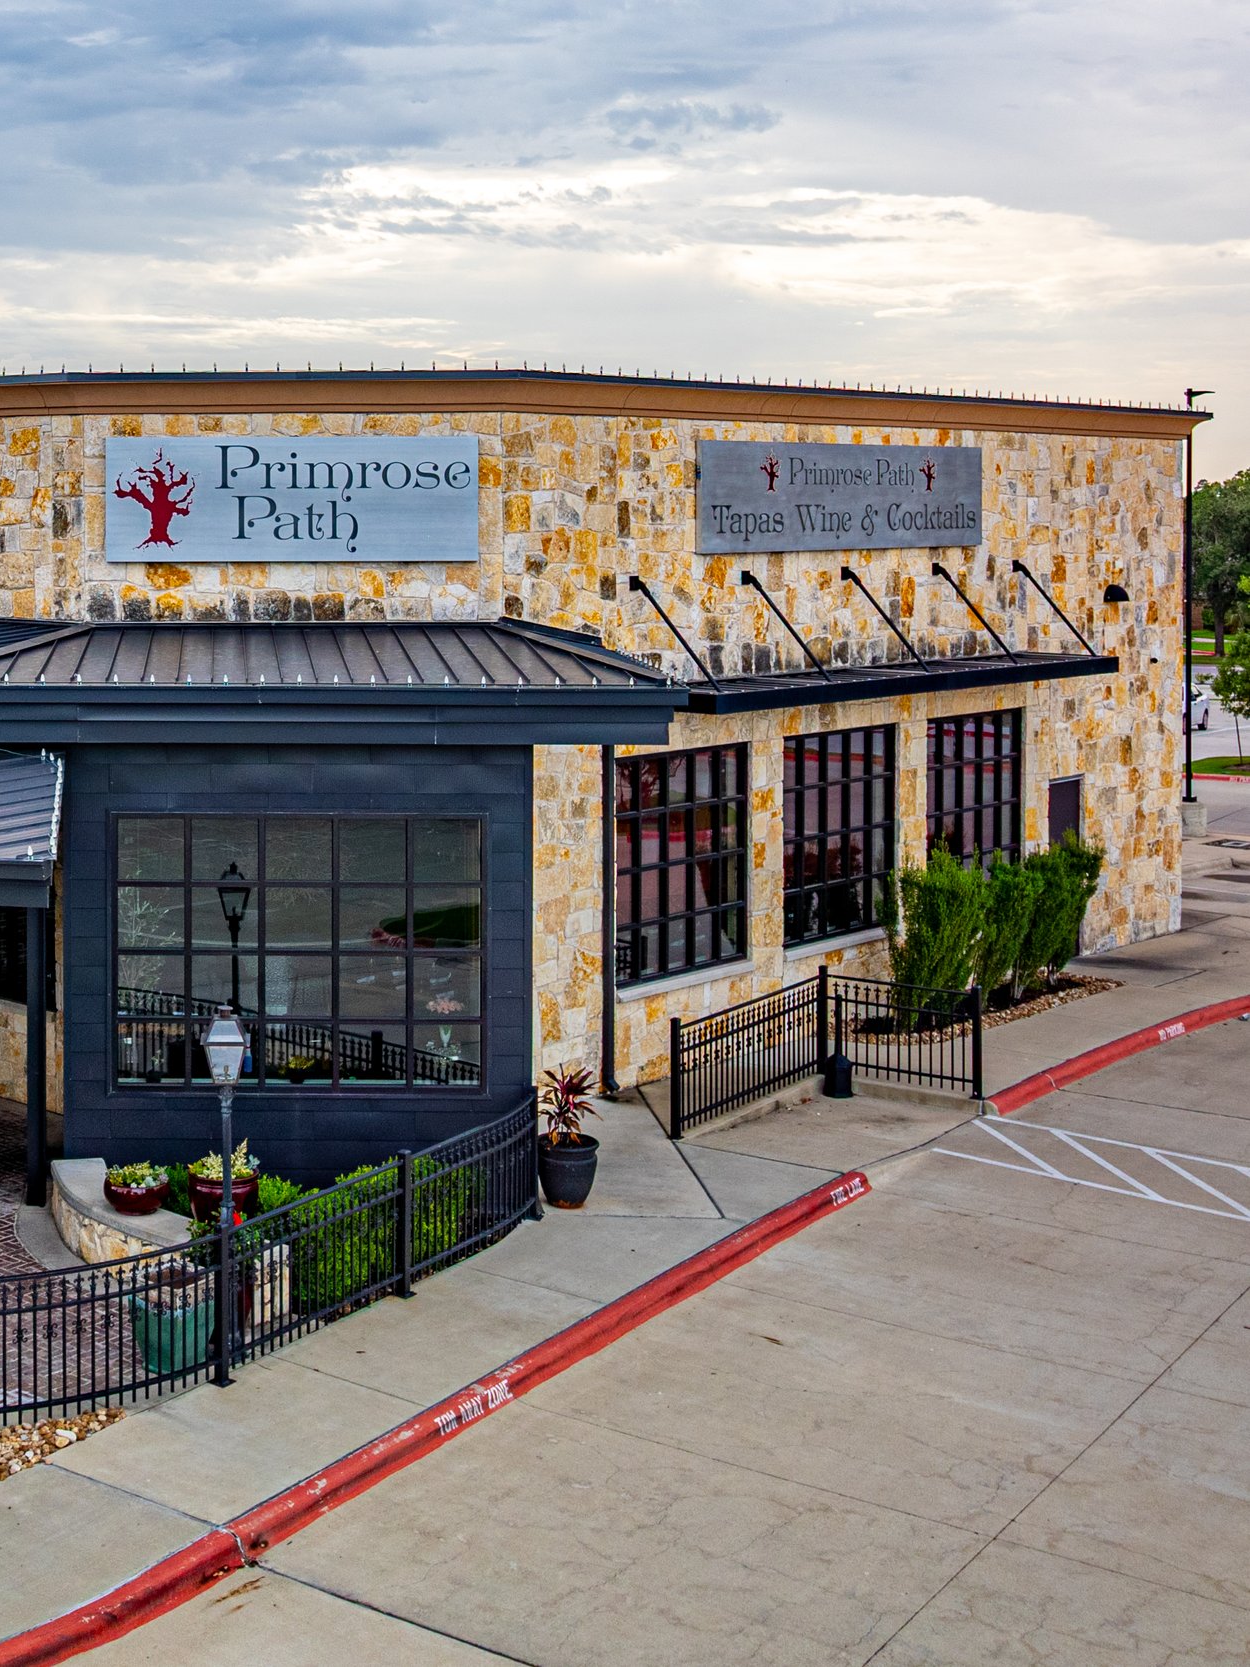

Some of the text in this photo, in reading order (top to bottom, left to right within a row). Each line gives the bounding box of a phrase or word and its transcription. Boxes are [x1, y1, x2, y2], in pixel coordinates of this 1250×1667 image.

[214, 445, 471, 502] Primrose
[788, 457, 915, 493] Primrose Path
[231, 495, 359, 553] Path
[711, 502, 977, 541] Tapas Wine & Cocktails
[433, 1379, 514, 1436] TOW AWAY ZONE
